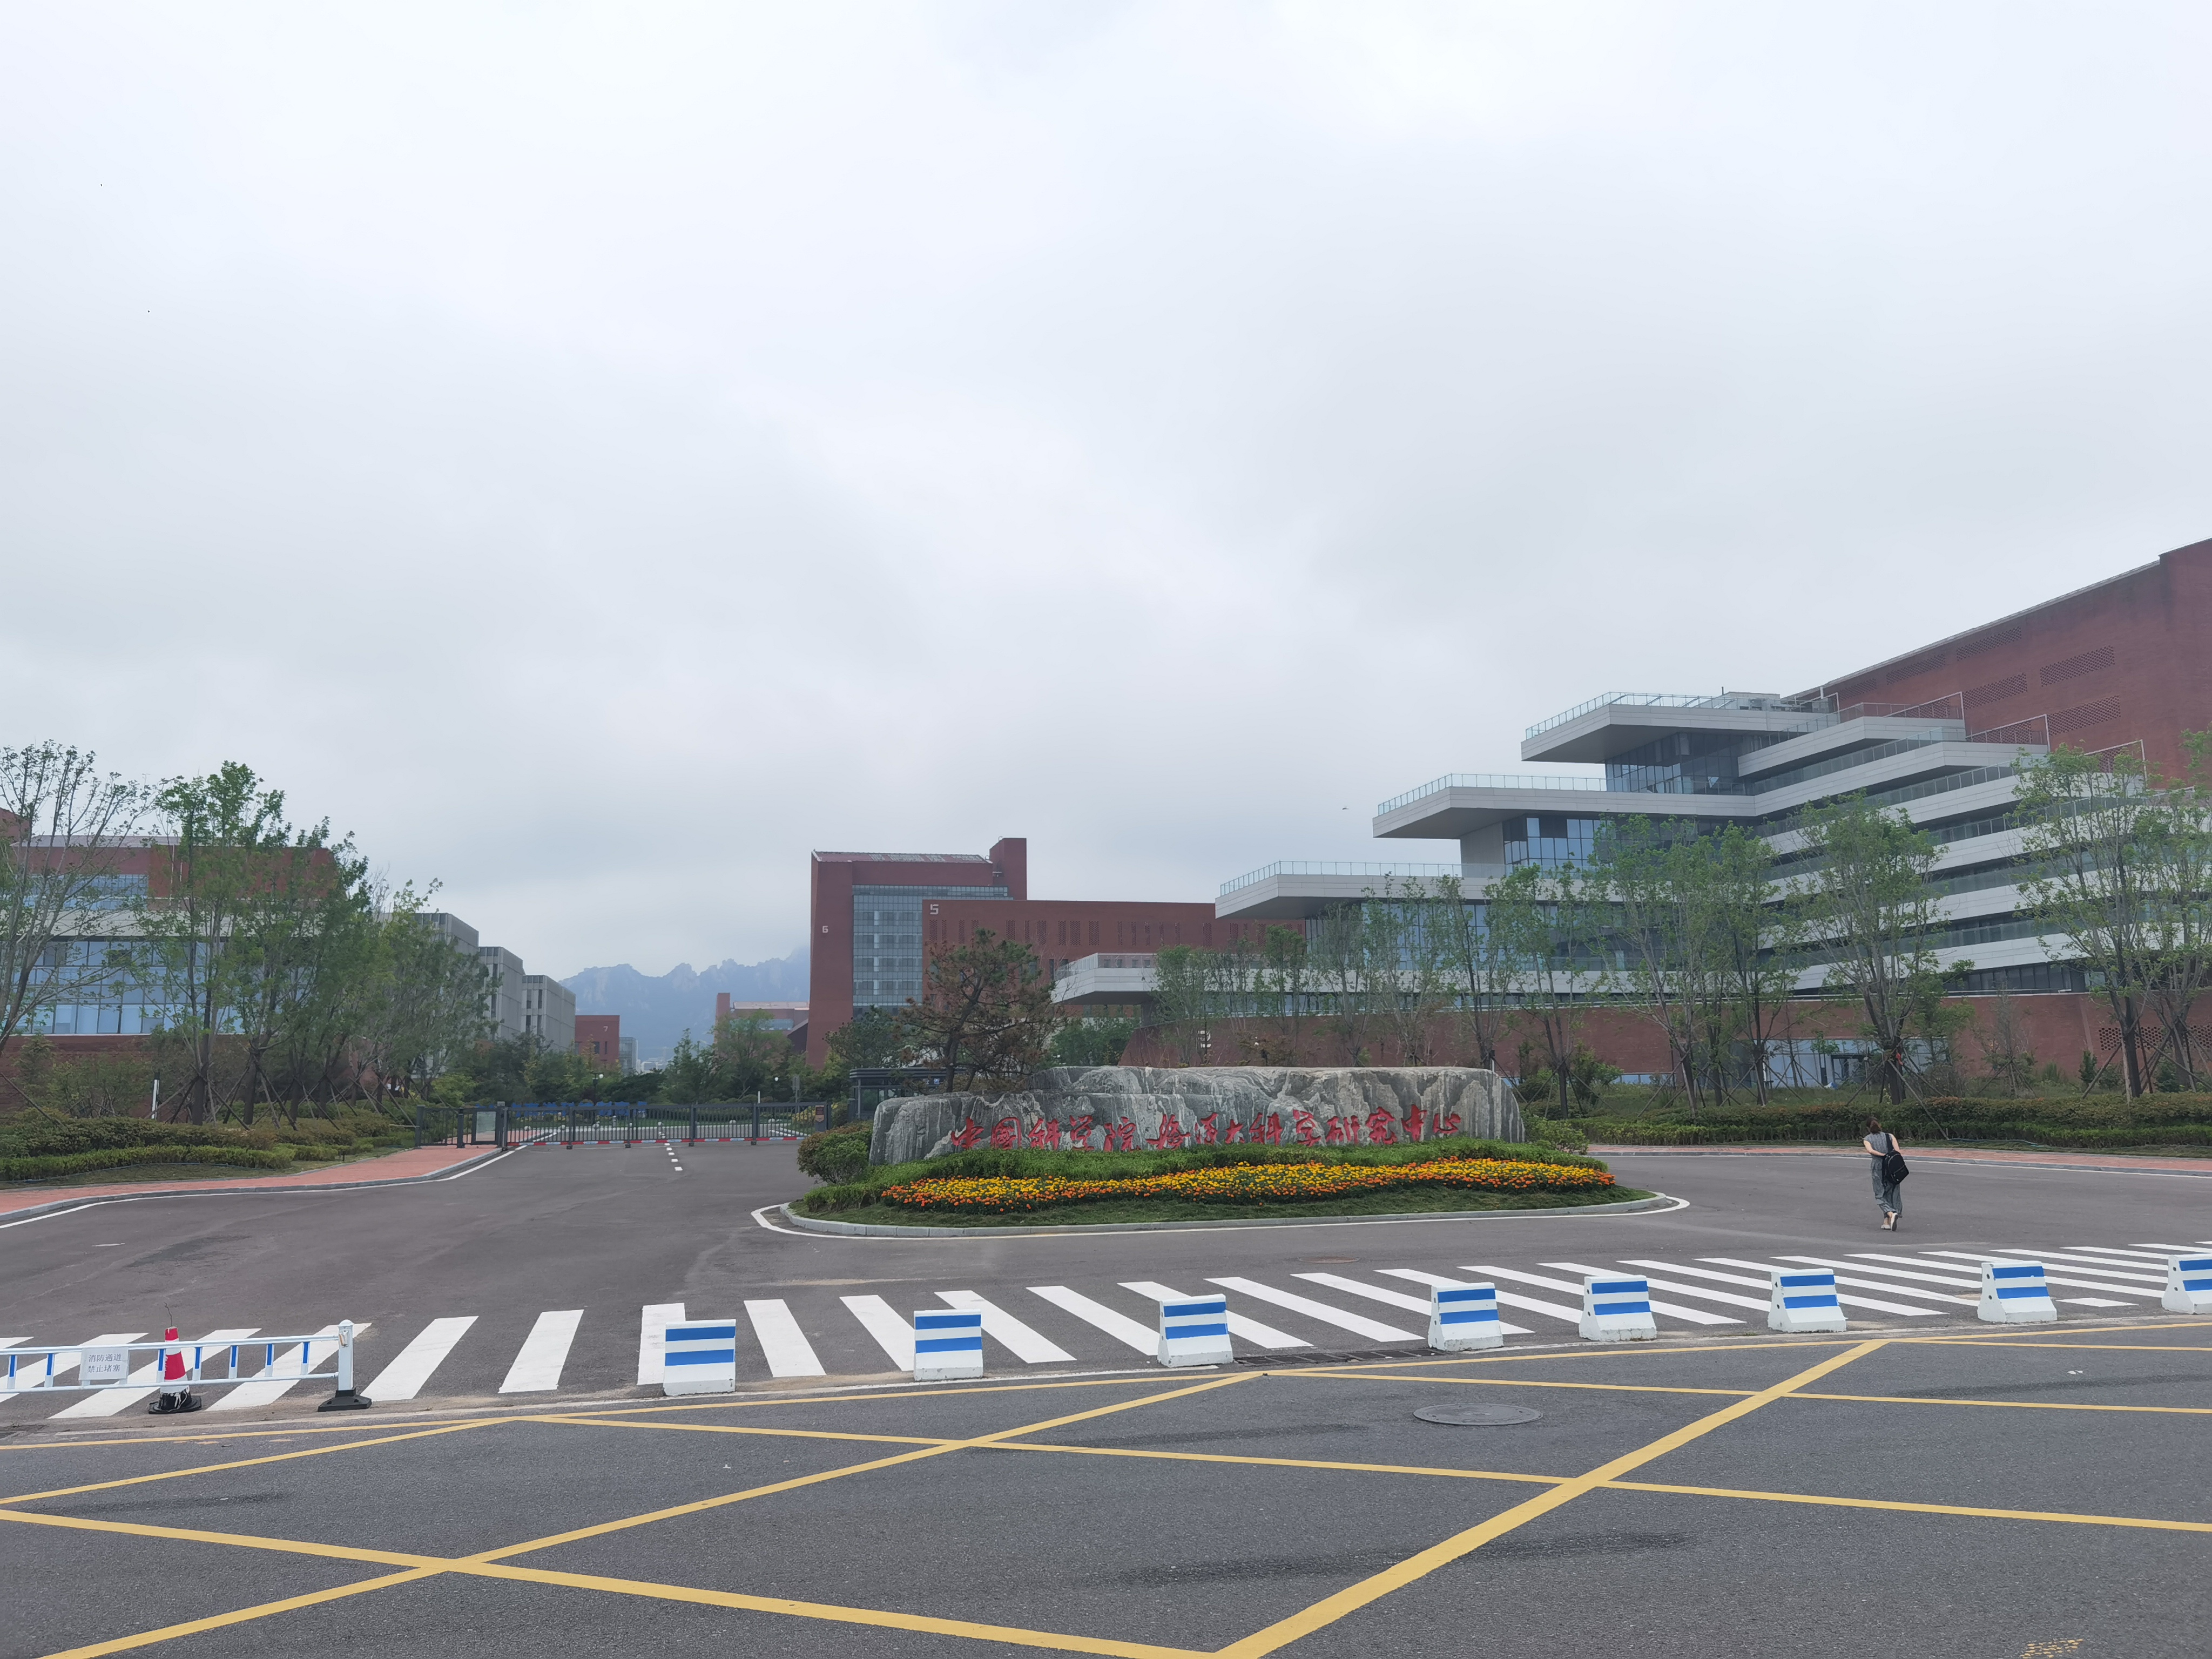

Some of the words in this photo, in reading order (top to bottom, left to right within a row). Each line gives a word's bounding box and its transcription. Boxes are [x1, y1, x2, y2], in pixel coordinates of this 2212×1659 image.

[930, 904, 939, 915] 5
[822, 925, 829, 933] 6
[88, 1353, 122, 1363] 消防通道
[87, 1364, 120, 1373] 禁止堵塞
